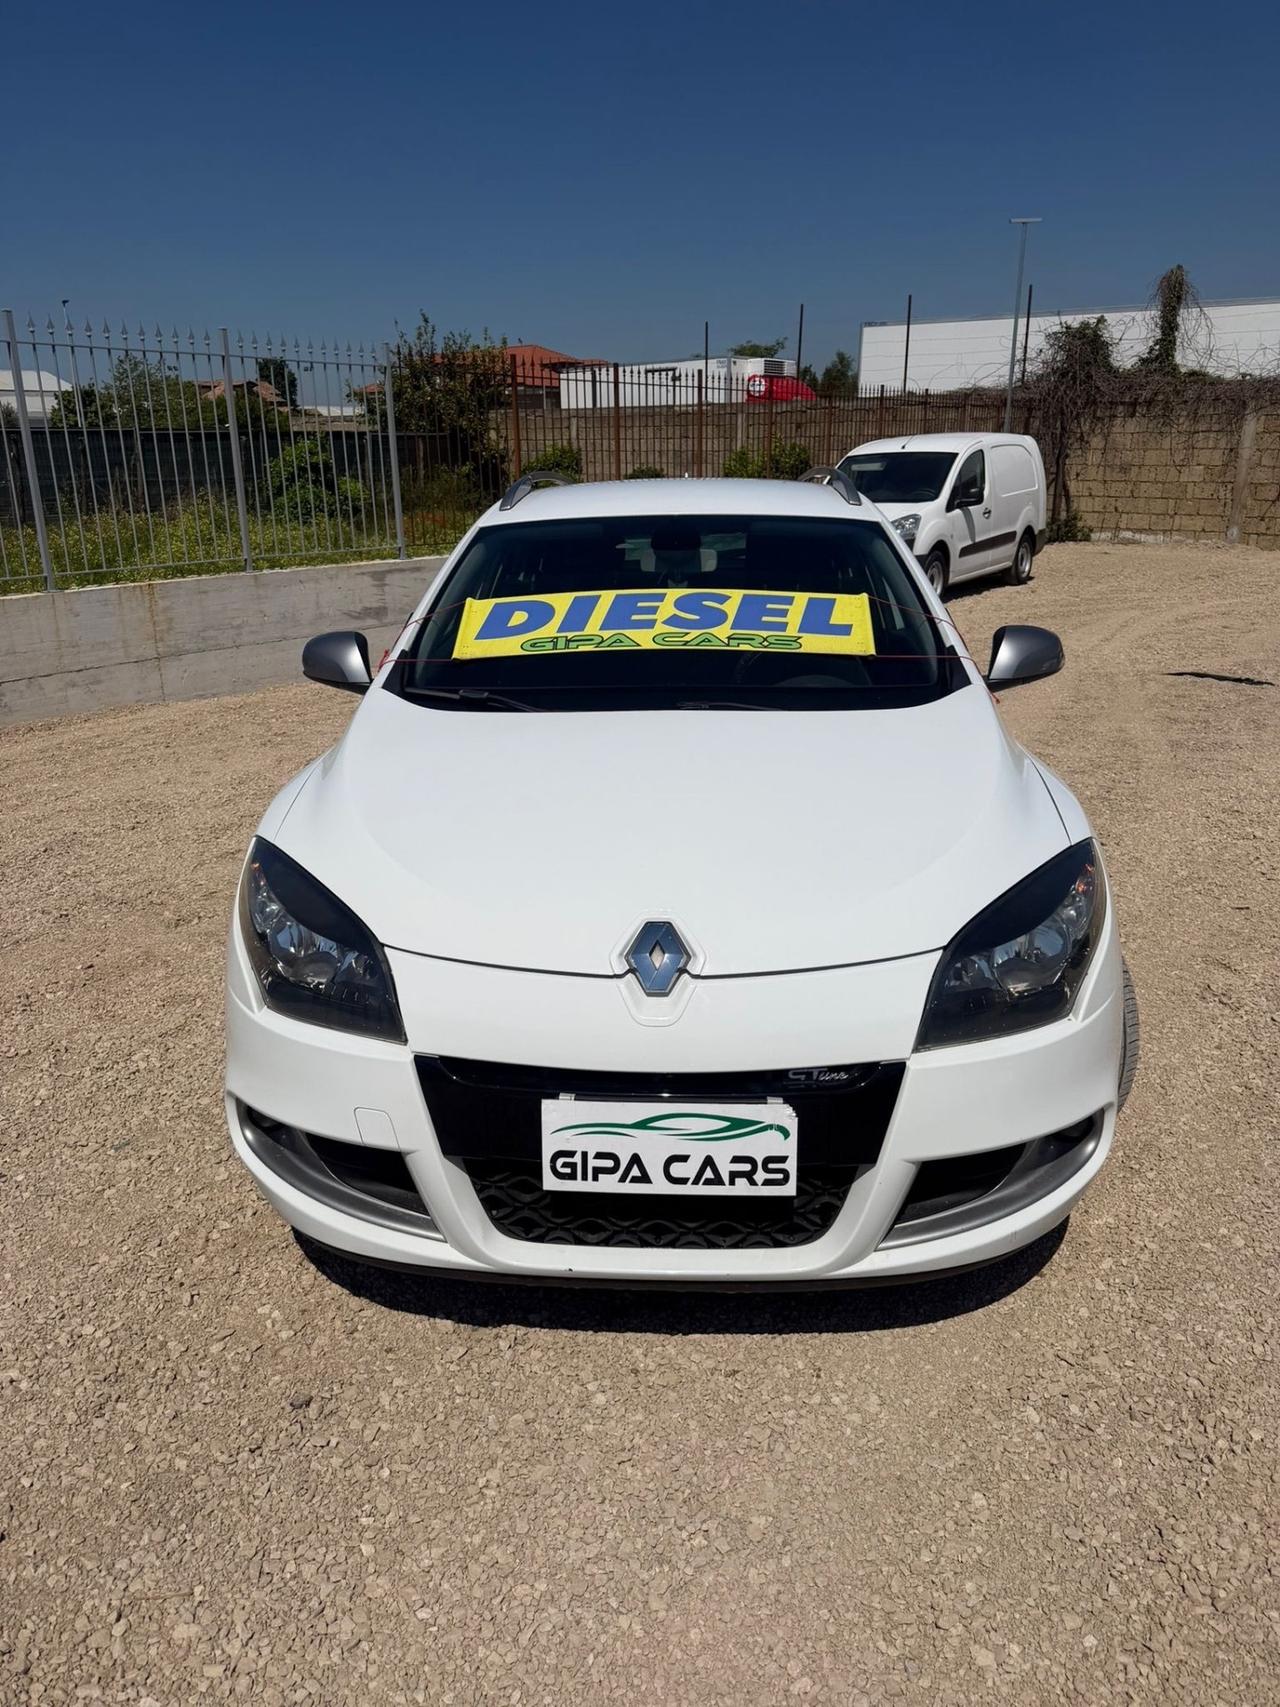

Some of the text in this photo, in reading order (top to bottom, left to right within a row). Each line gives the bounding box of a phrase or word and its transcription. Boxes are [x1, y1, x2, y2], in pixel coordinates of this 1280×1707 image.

[475, 592, 853, 640] DIESEL
[520, 631, 803, 652] GIPA CARS
[550, 1150, 791, 1187] GIPA CARS
